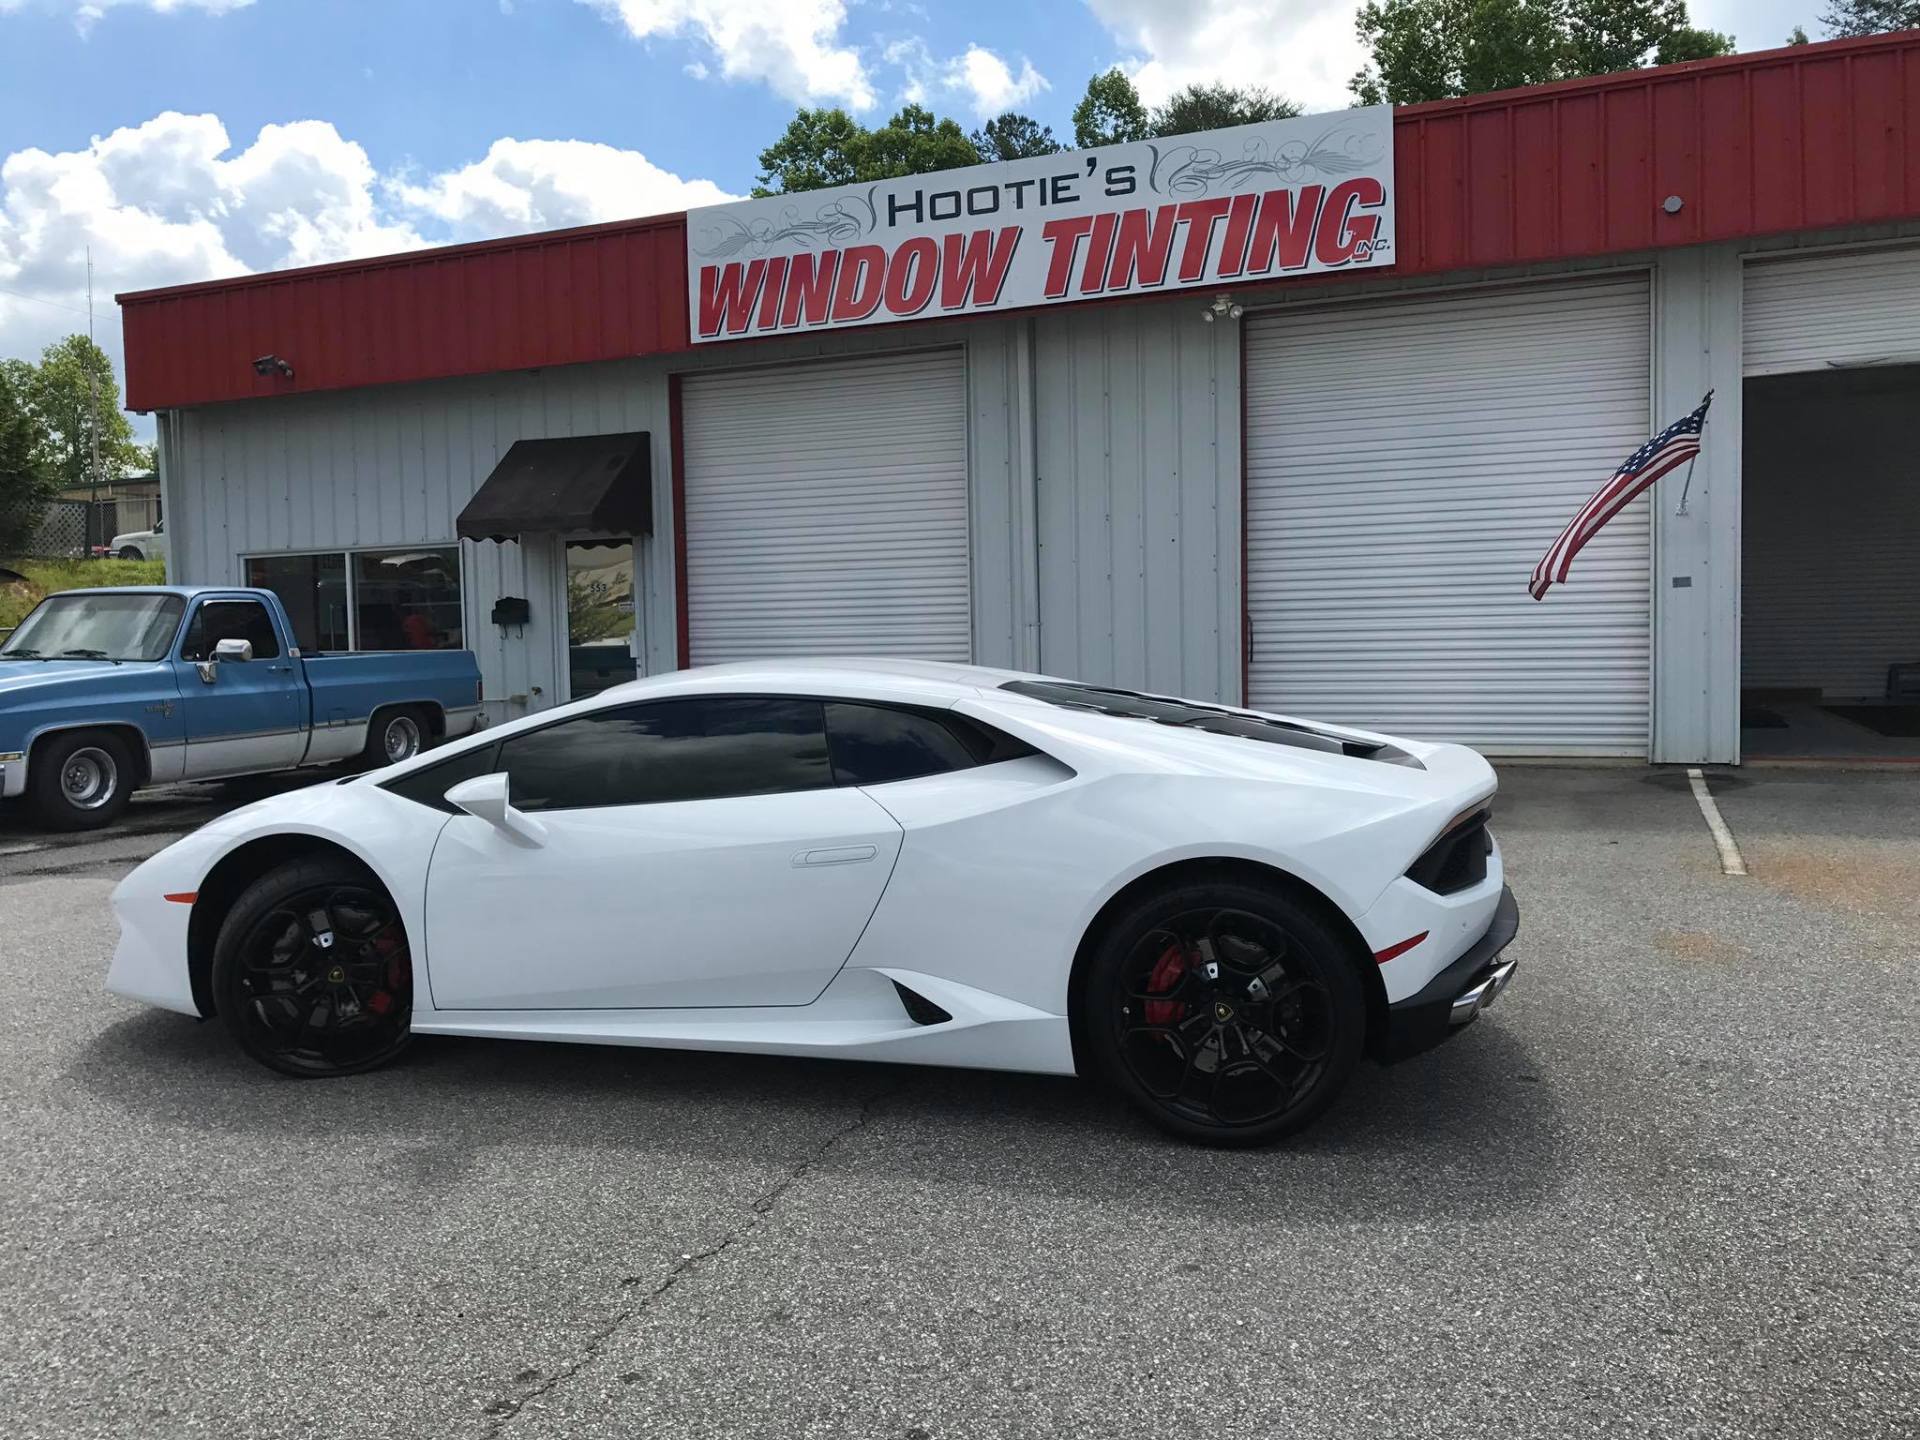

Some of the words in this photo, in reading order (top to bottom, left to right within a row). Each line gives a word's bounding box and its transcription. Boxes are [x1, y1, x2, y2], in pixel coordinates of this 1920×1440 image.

[888, 157, 1136, 227] HOOTIE'S
[698, 225, 1024, 338] WINDOW
[1042, 177, 1386, 299] TINTING
[1356, 239, 1391, 253] INC.
